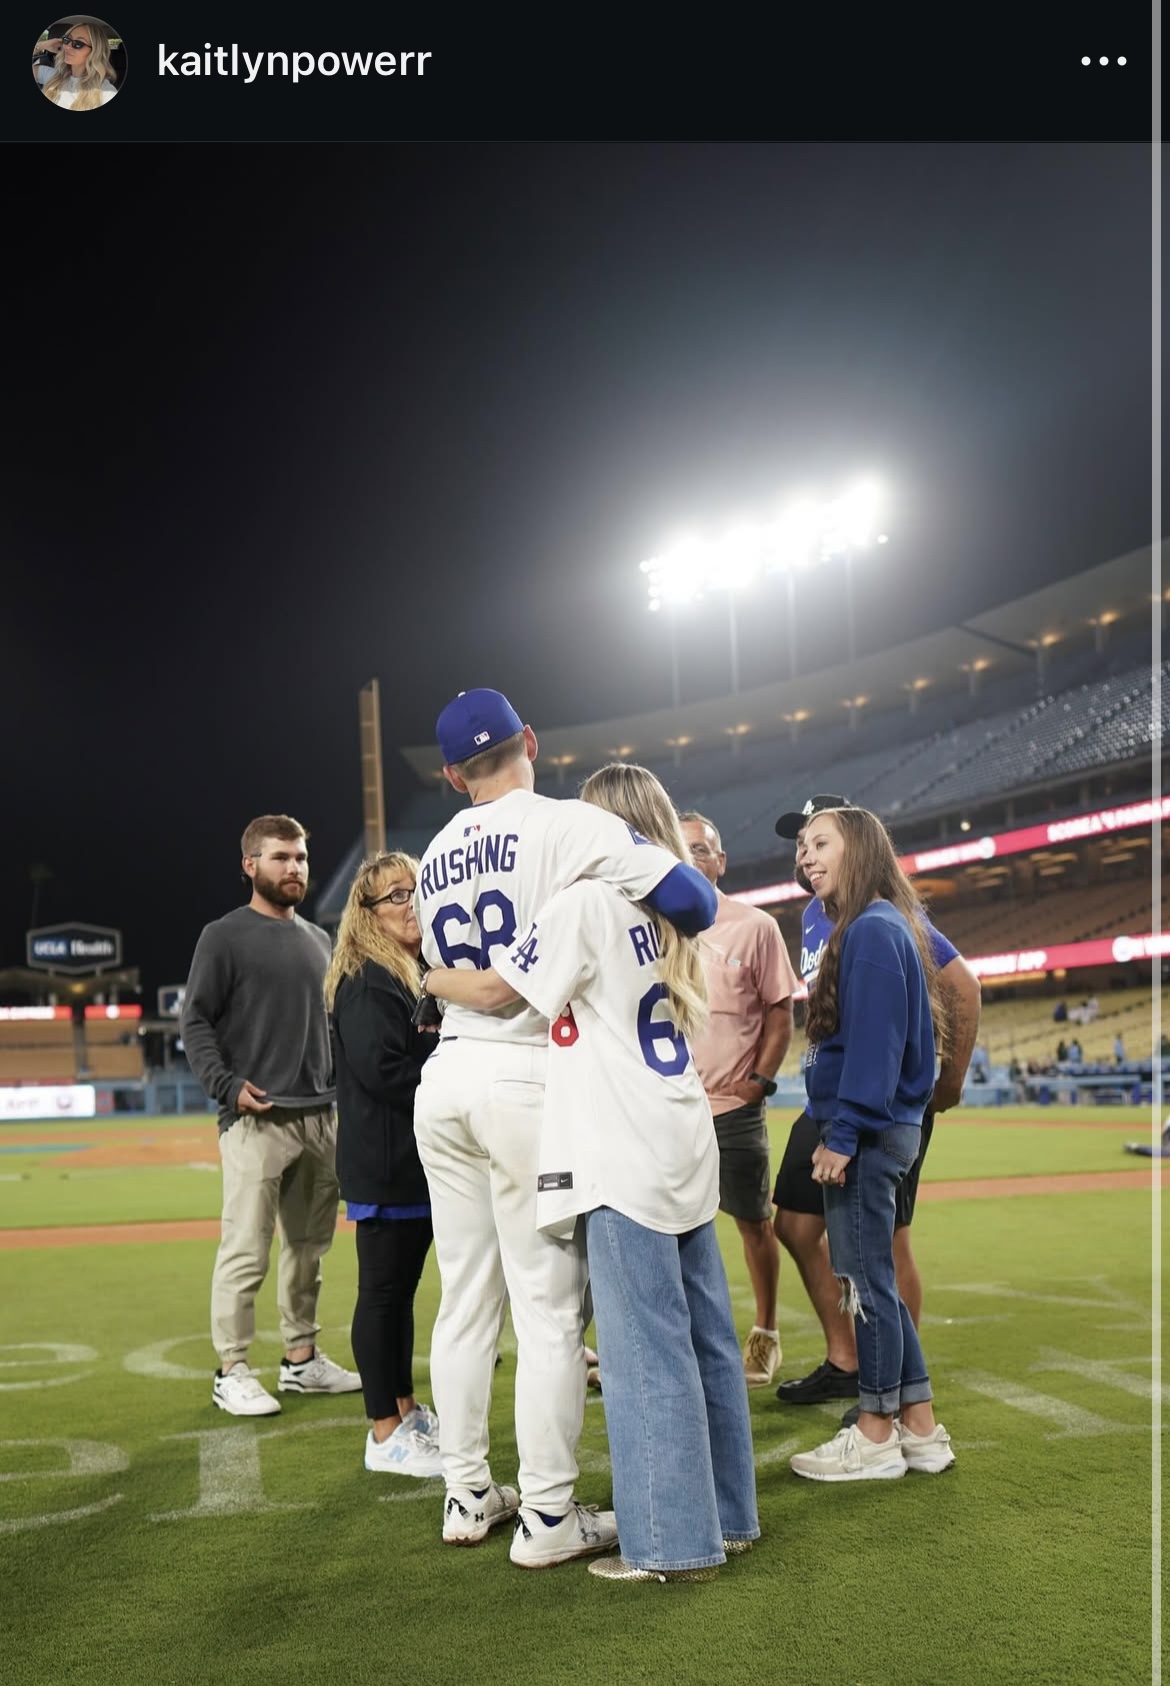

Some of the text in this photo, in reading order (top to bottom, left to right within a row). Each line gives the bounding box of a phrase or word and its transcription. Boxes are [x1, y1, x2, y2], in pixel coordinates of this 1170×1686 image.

[420, 833, 519, 900] RUSHING
[34, 940, 113, 955] UCLA Health
[431, 889, 517, 971] 68
[510, 922, 539, 974] LA
[637, 982, 690, 1077] 6
